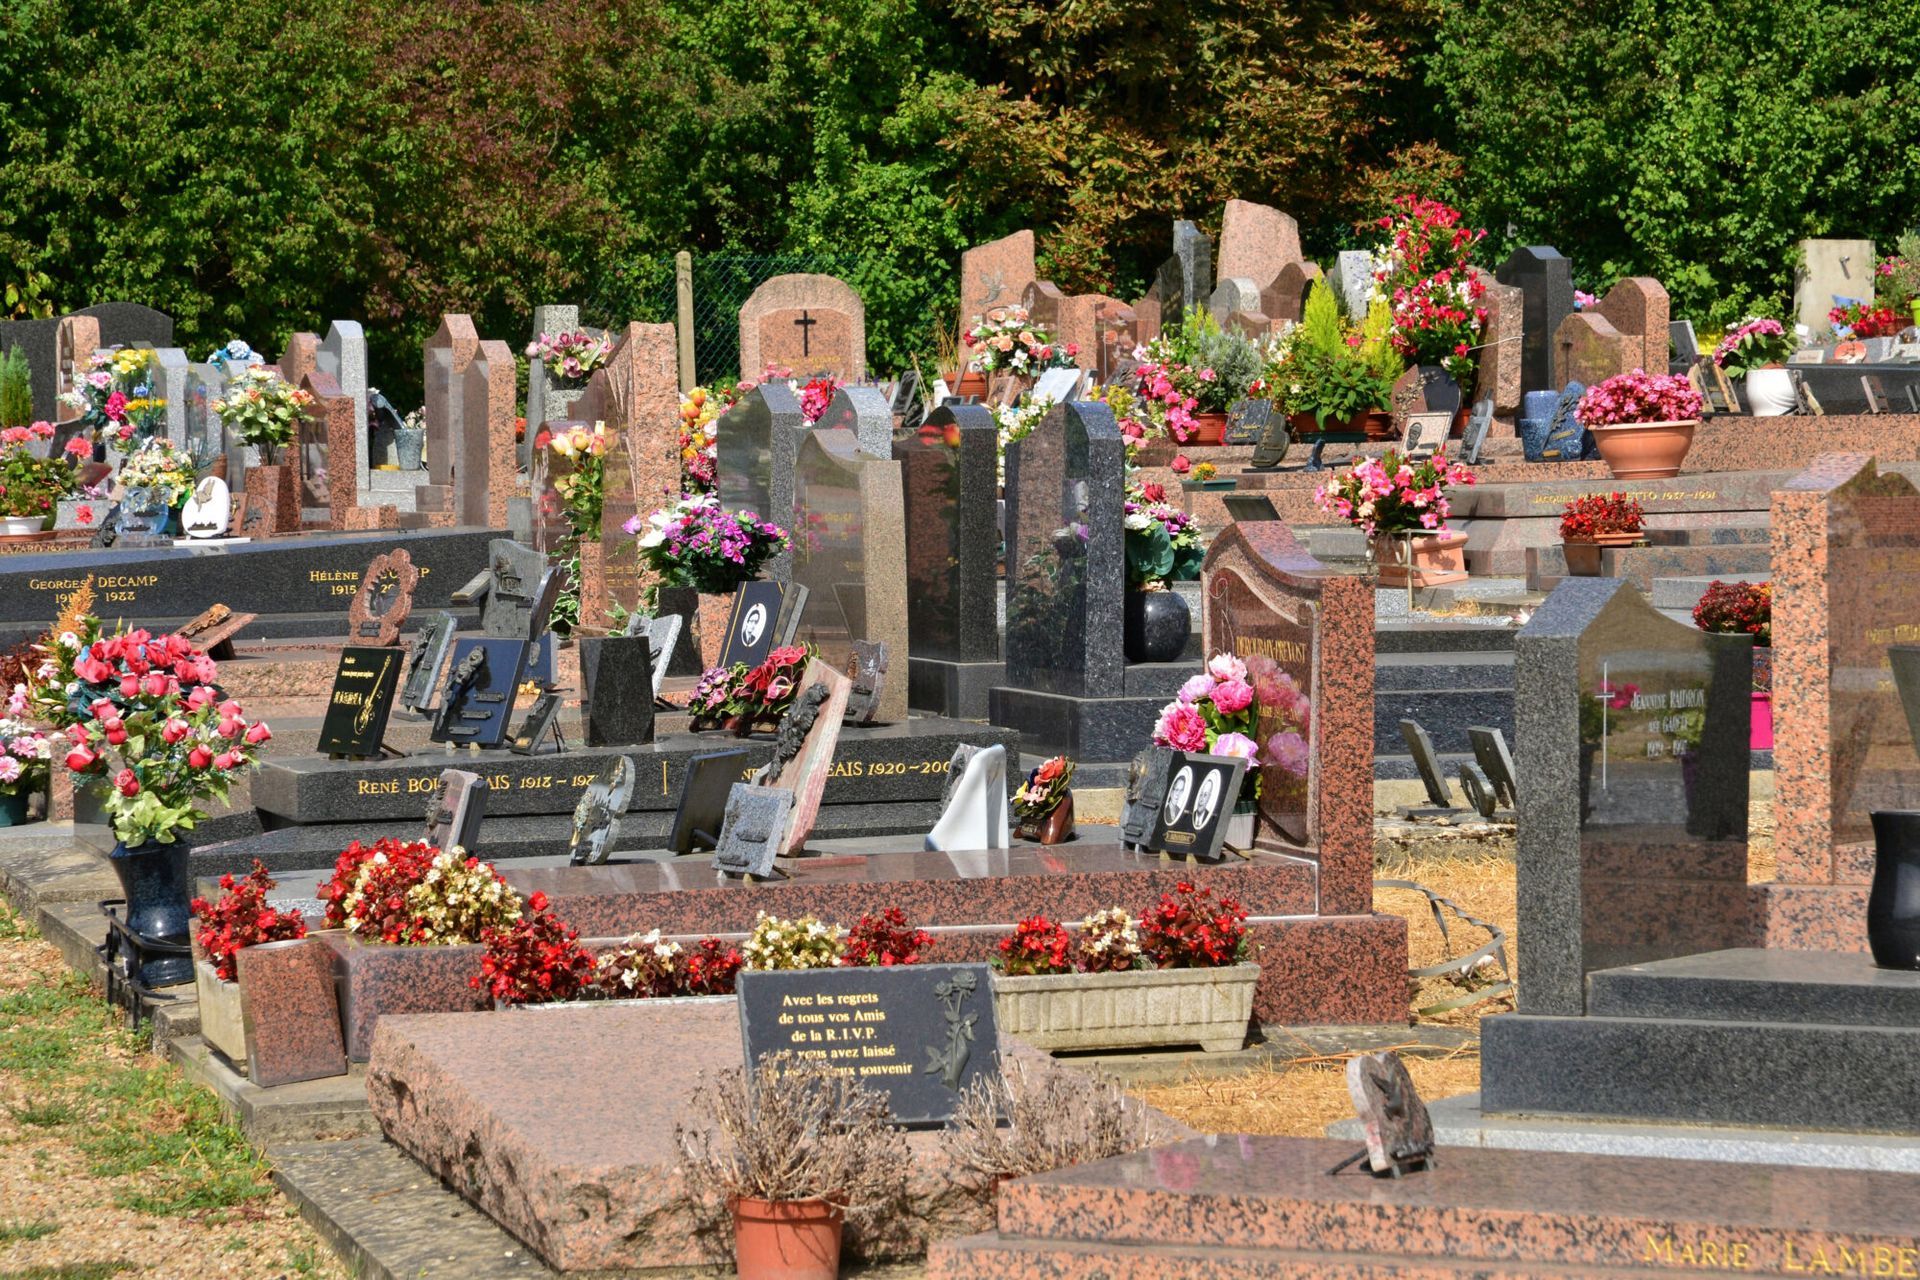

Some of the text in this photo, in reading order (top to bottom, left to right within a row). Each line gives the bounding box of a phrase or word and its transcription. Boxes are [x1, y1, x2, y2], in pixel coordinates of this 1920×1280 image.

[98, 575, 158, 588] DECAMP
[310, 569, 359, 582] HÉLÈNE
[330, 584, 357, 596] 1915
[783, 992, 879, 1007] Avec les regrets
[779, 1008, 886, 1025] de tous vos Amis
[791, 1026, 878, 1042] de la R.I.V.P.
[831, 1048, 860, 1059] avez
[863, 1044, 896, 1058] laissé
[859, 1062, 913, 1077] souvenir
[1643, 1231, 1751, 1268] MARIE
